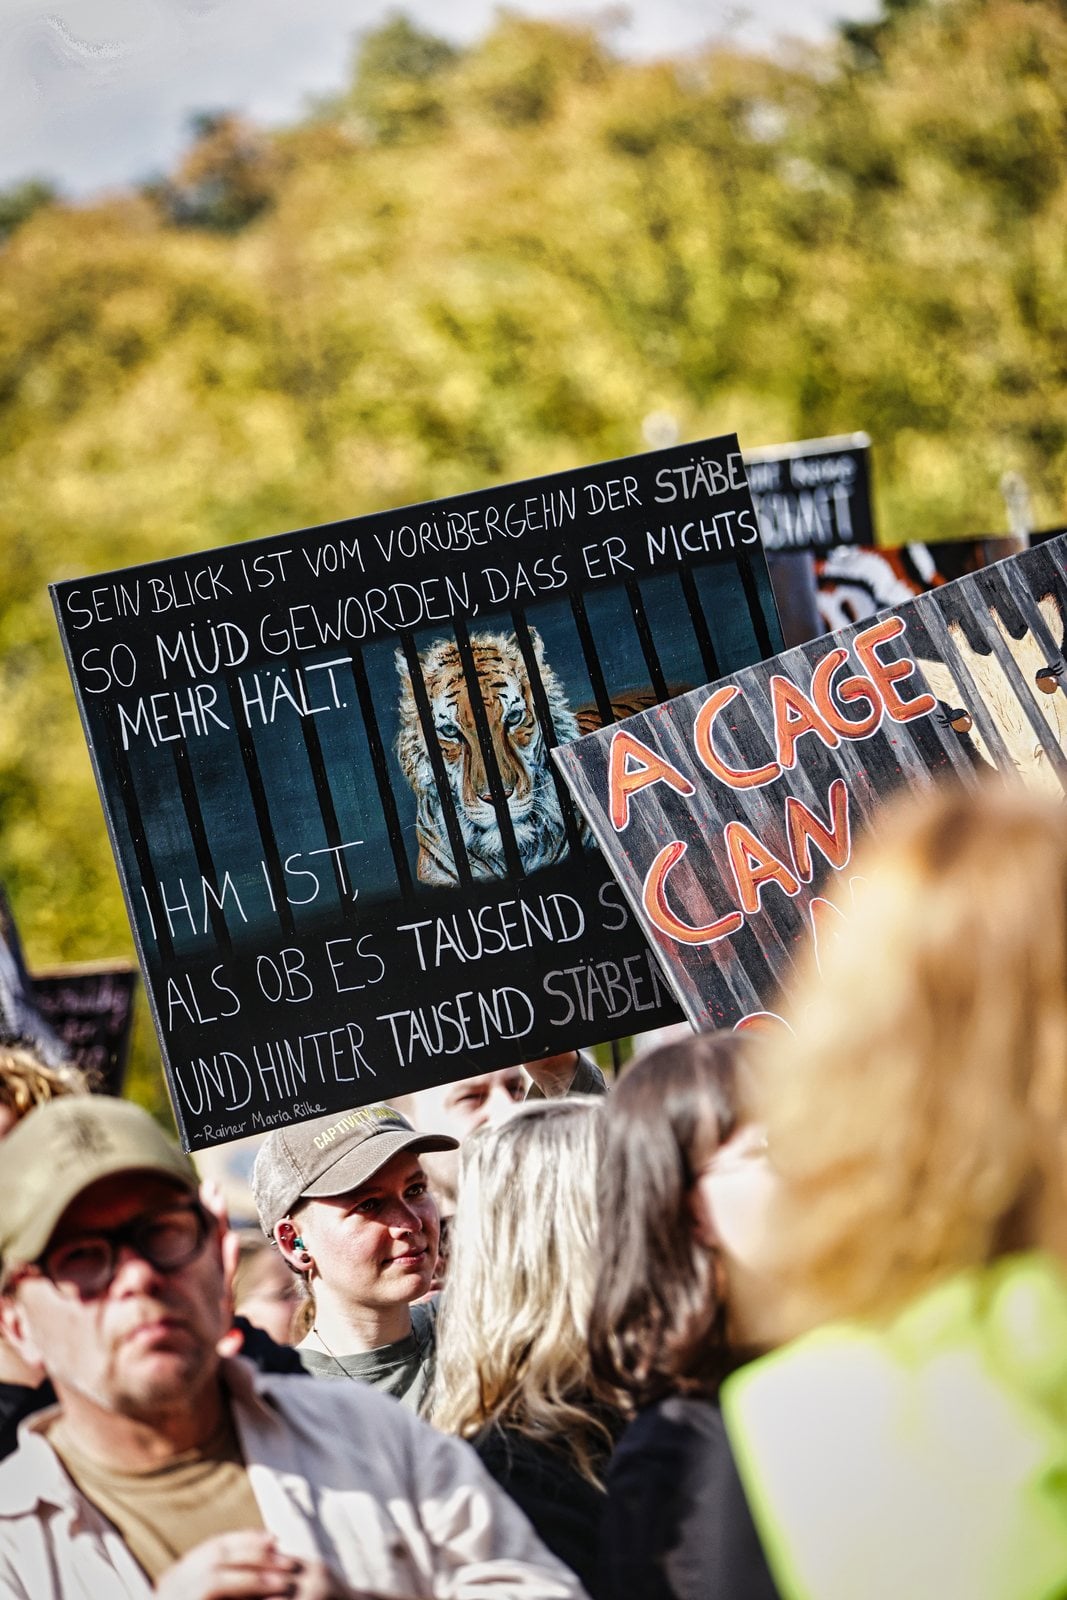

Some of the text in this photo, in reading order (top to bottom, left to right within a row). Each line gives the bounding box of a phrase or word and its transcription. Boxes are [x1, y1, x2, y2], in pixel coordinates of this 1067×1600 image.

[67, 580, 139, 630] SEIN
[147, 564, 233, 613] BLICK
[241, 550, 292, 592] IST
[302, 536, 365, 577] VOM
[373, 487, 576, 562] VORÜBERGEHN
[583, 476, 642, 515] DER
[654, 452, 748, 503] STÄBE
[81, 643, 136, 693] SO
[156, 620, 249, 680] MÜD
[260, 572, 478, 655] GEWORDEN,
[481, 554, 568, 603] DASS
[582, 537, 635, 579] ER
[646, 509, 758, 565] NICHTS
[117, 657, 352, 750] MEHR HÄLT.
[608, 616, 938, 832] A CAGE
[141, 841, 364, 940] IHM IST,
[642, 778, 851, 945] CAN
[169, 964, 241, 1032] ALS
[256, 948, 313, 1002] OB
[325, 934, 385, 993] ES
[397, 893, 585, 971] TAUSEND
[175, 1052, 252, 1115] UND
[253, 1022, 376, 1101] HINTER
[376, 986, 535, 1067] TAUSEND
[251, 1110, 292, 1129] Maria
[293, 1101, 327, 1118] Rilke
[313, 1109, 372, 1150] CAPTIVITY
